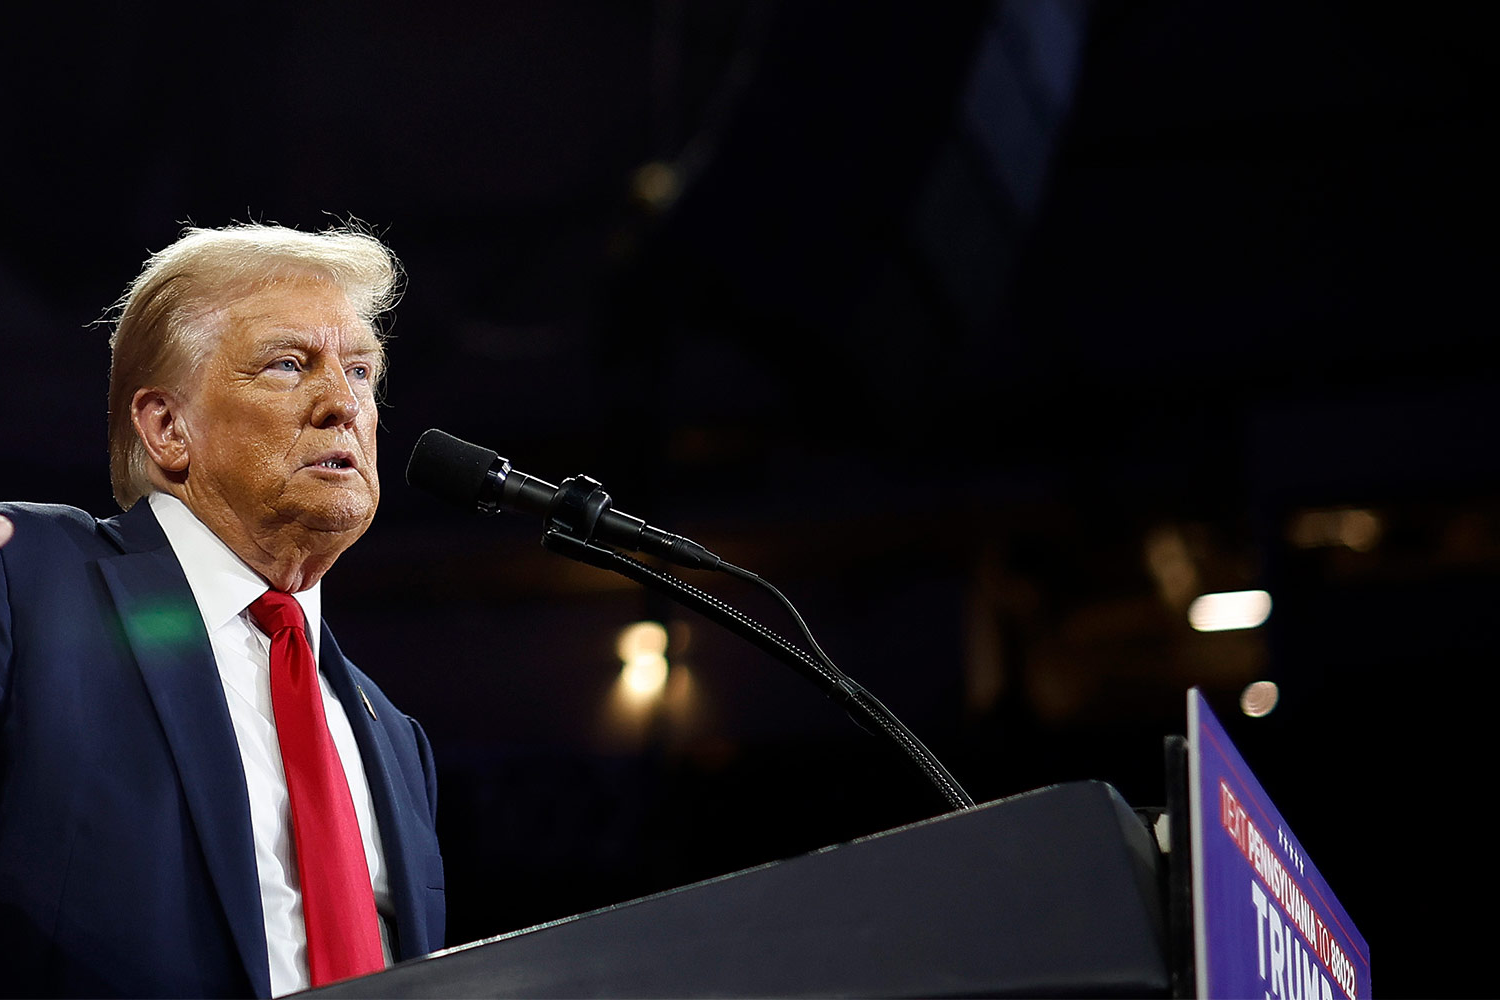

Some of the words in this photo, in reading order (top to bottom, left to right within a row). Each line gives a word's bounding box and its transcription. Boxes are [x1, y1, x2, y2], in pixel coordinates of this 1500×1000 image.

[1221, 782, 1246, 852] TEXT
[1248, 821, 1318, 951] PENNSYLVANIA
[1317, 919, 1330, 967] TO
[1331, 939, 1356, 1000] 88022
